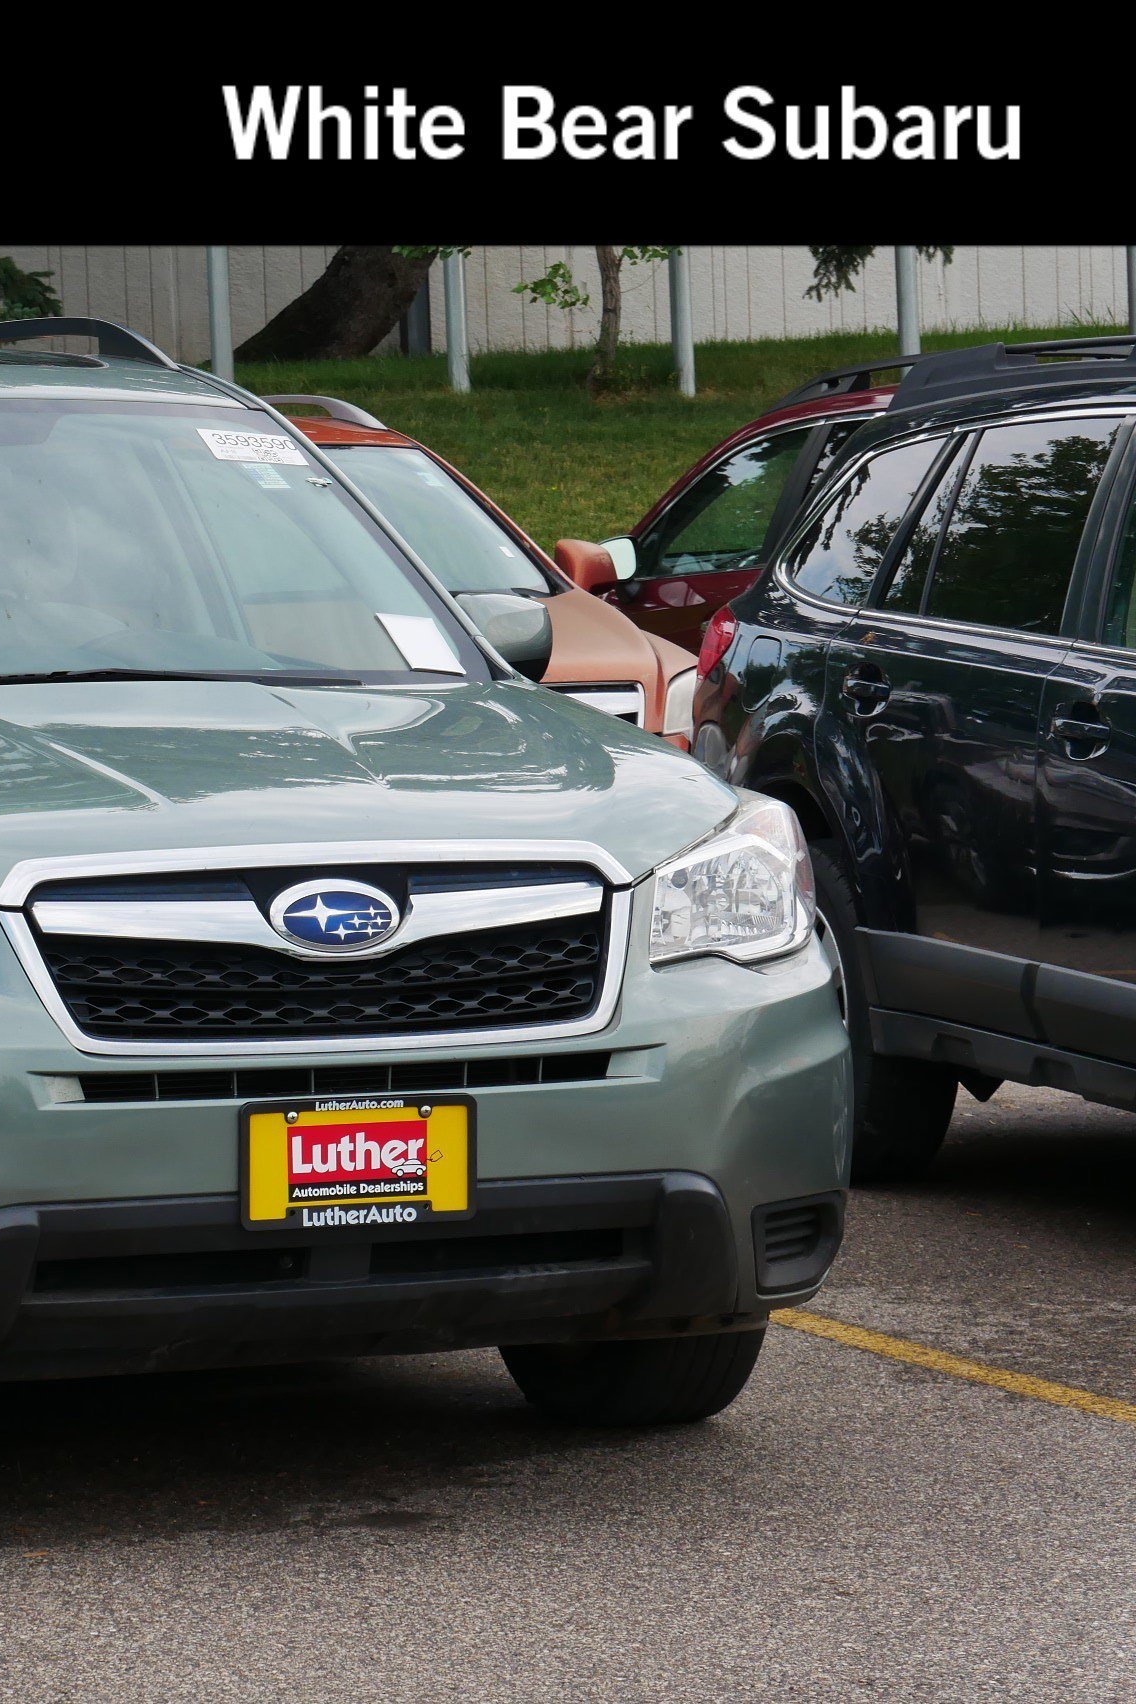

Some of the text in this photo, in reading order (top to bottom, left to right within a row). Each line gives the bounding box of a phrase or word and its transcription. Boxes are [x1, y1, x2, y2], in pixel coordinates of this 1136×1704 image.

[315, 1099, 404, 1112] LutherAuto.com
[291, 1131, 425, 1175] Luther
[292, 1181, 424, 1198] Automobile Dealerships
[302, 1204, 418, 1227] LutherAuto
